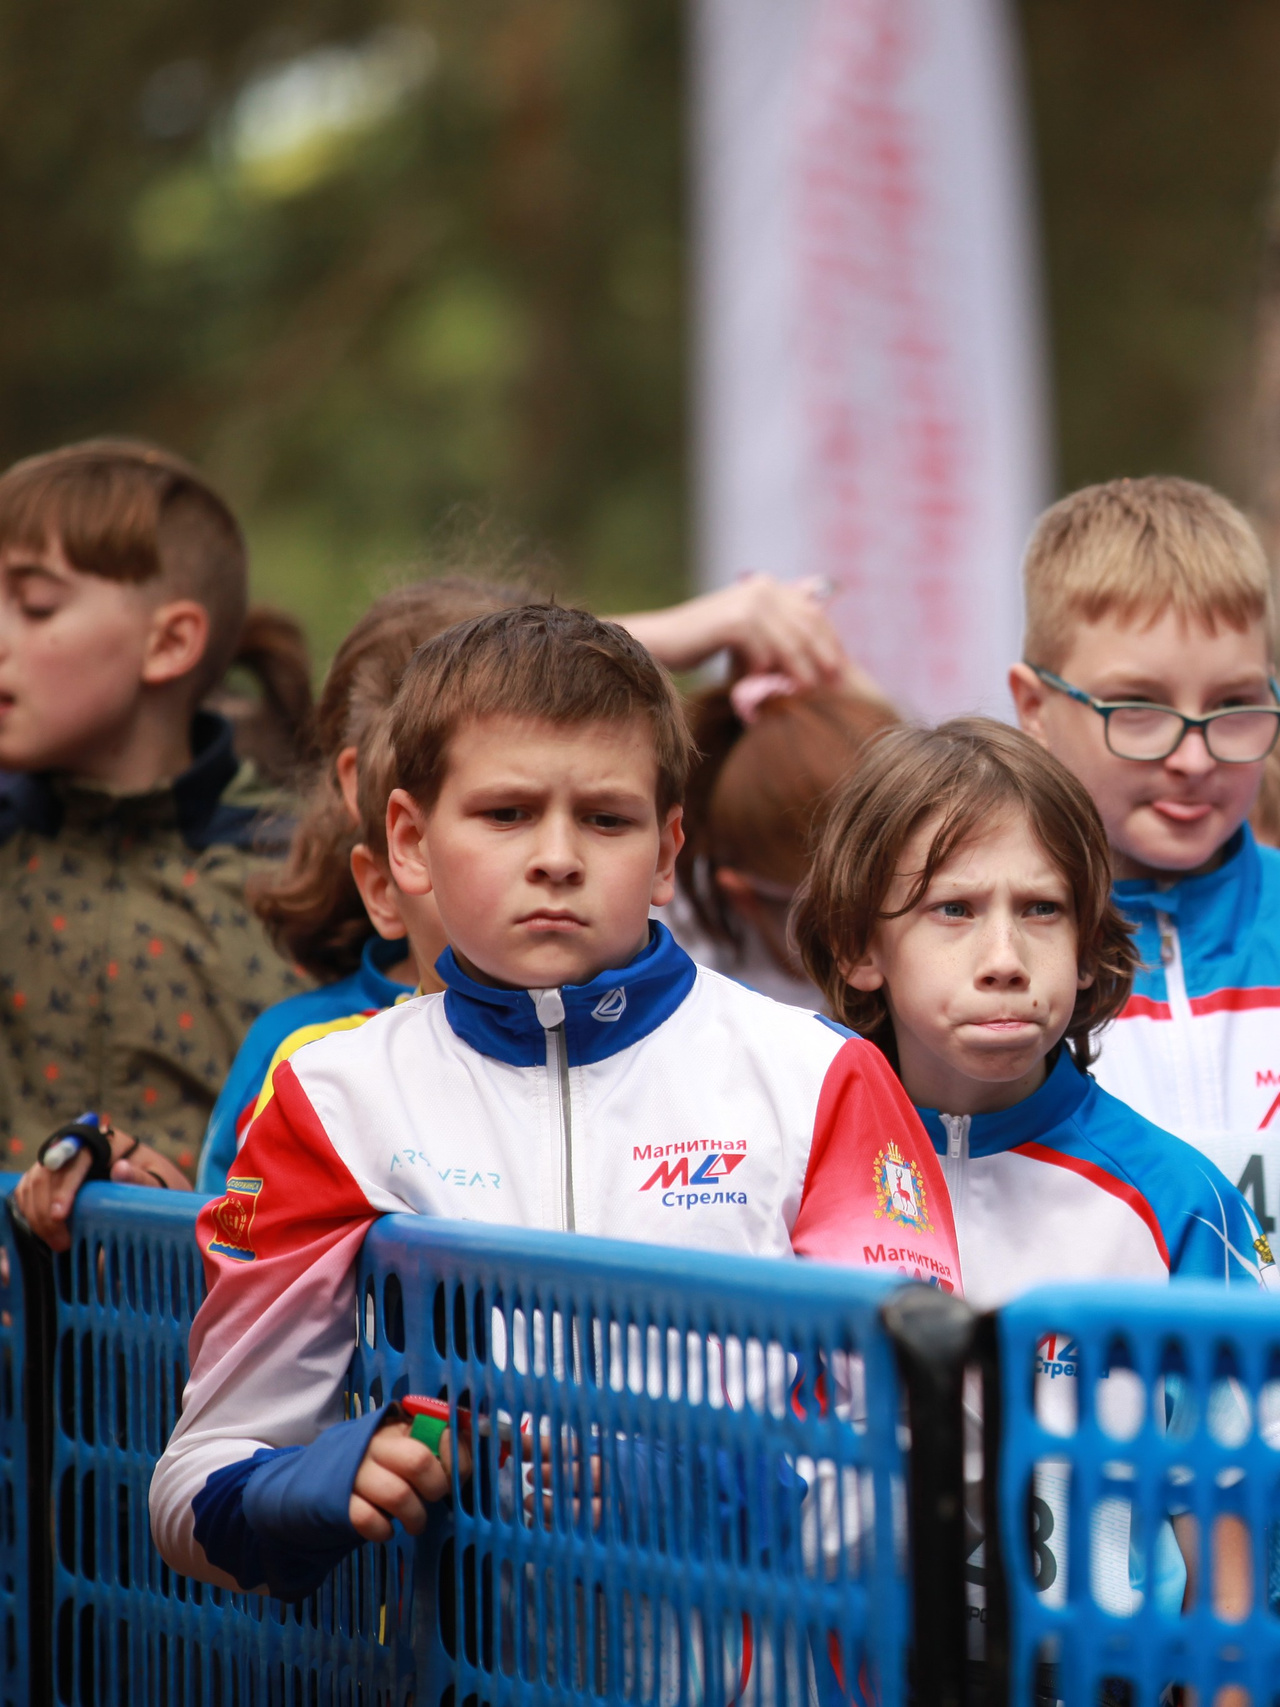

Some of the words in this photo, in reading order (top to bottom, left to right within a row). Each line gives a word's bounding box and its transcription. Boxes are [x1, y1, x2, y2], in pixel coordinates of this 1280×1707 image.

[633, 1139, 747, 1161] Магнитная
[661, 1191, 748, 1210] Стрелка
[863, 1243, 953, 1280] Магнитная
